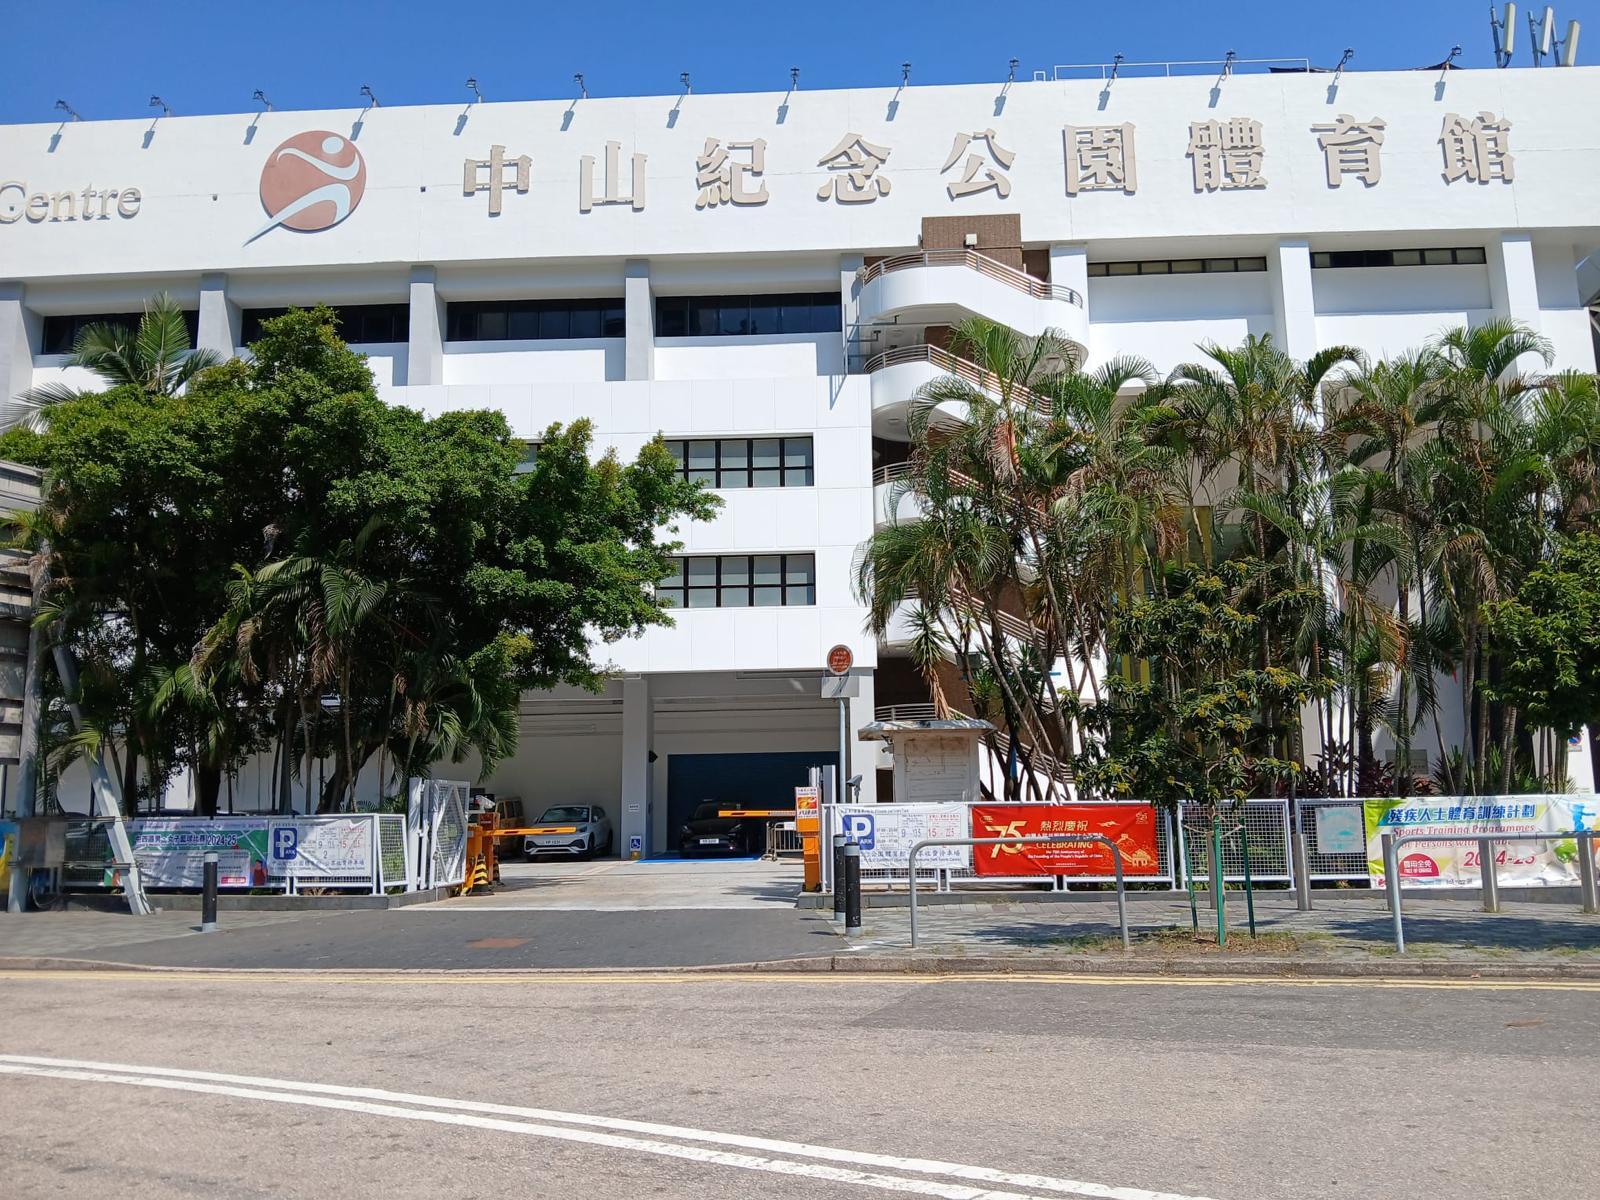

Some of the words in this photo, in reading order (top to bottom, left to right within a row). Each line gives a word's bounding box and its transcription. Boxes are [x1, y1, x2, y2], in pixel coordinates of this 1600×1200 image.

[464, 111, 1515, 217] 中山紀念公園體育館
[0, 180, 142, 224] Centre
[1389, 804, 1535, 823] 殘疾人士體育訓練計劃
[1040, 820, 1089, 832] 熱烈慶祝
[1394, 827, 1424, 837] Sports
[1427, 825, 1469, 835] Training
[1472, 824, 1535, 834] Programmes
[207, 834, 238, 846] 2024-25
[1036, 841, 1093, 849] CELEBRATING
